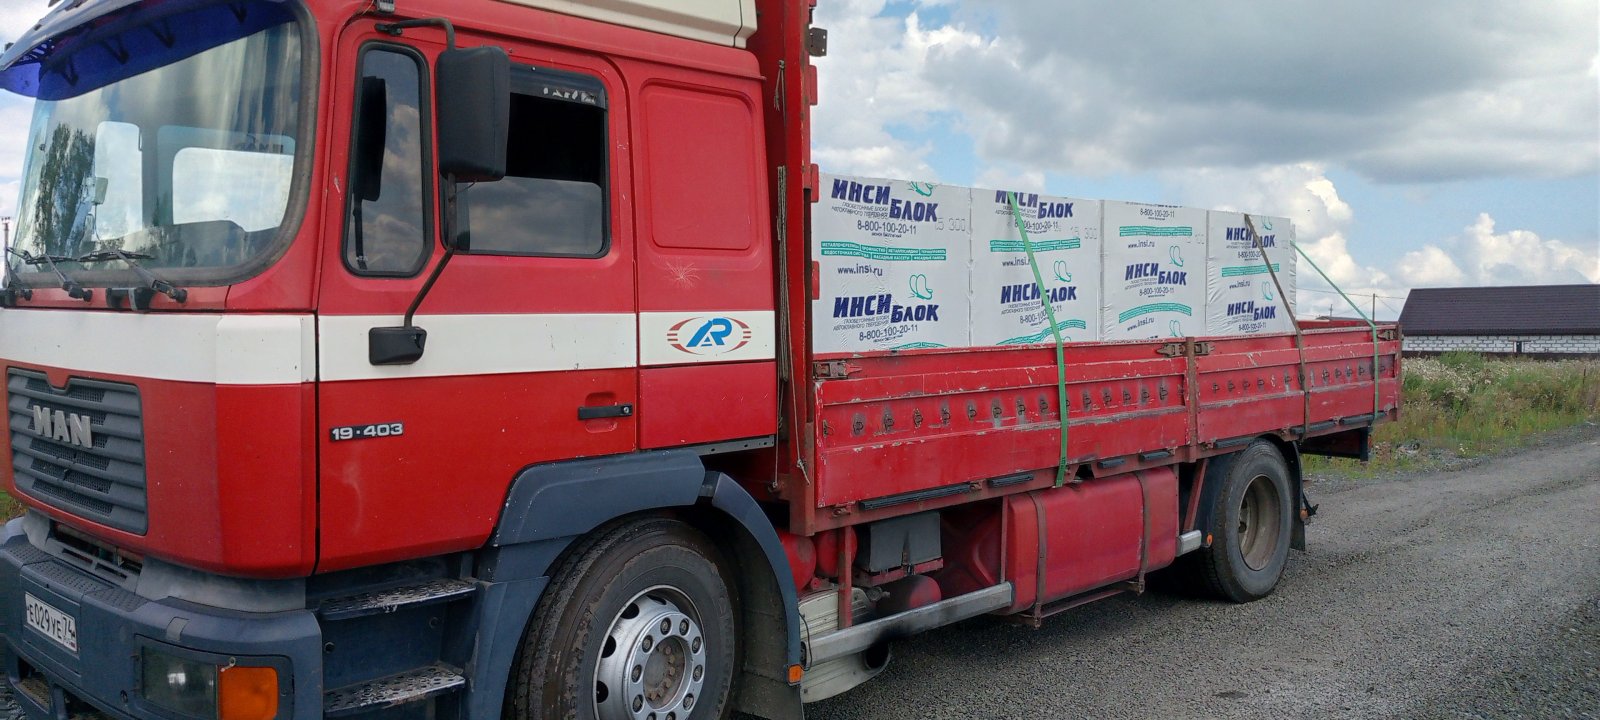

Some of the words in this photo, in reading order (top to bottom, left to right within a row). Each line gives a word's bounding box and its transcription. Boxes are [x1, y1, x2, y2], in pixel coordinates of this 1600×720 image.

[831, 178, 890, 205] ИНСИ
[889, 199, 939, 222] БЛОК
[1037, 202, 1074, 219] БЛОК
[857, 219, 917, 235] 8-800-100-20-11
[837, 263, 883, 276] www.insi.ru
[1125, 263, 1158, 280] ИНСИ
[1158, 271, 1187, 286] БЛОК
[1000, 282, 1041, 304] ИНСИ
[833, 294, 892, 318] ИНСИ
[890, 304, 939, 323] БЛОК
[1227, 301, 1254, 316] ИНСИ
[1253, 306, 1276, 320] БЛОК
[859, 324, 919, 341] 8-800-100-20-11
[33, 405, 92, 449] MAN
